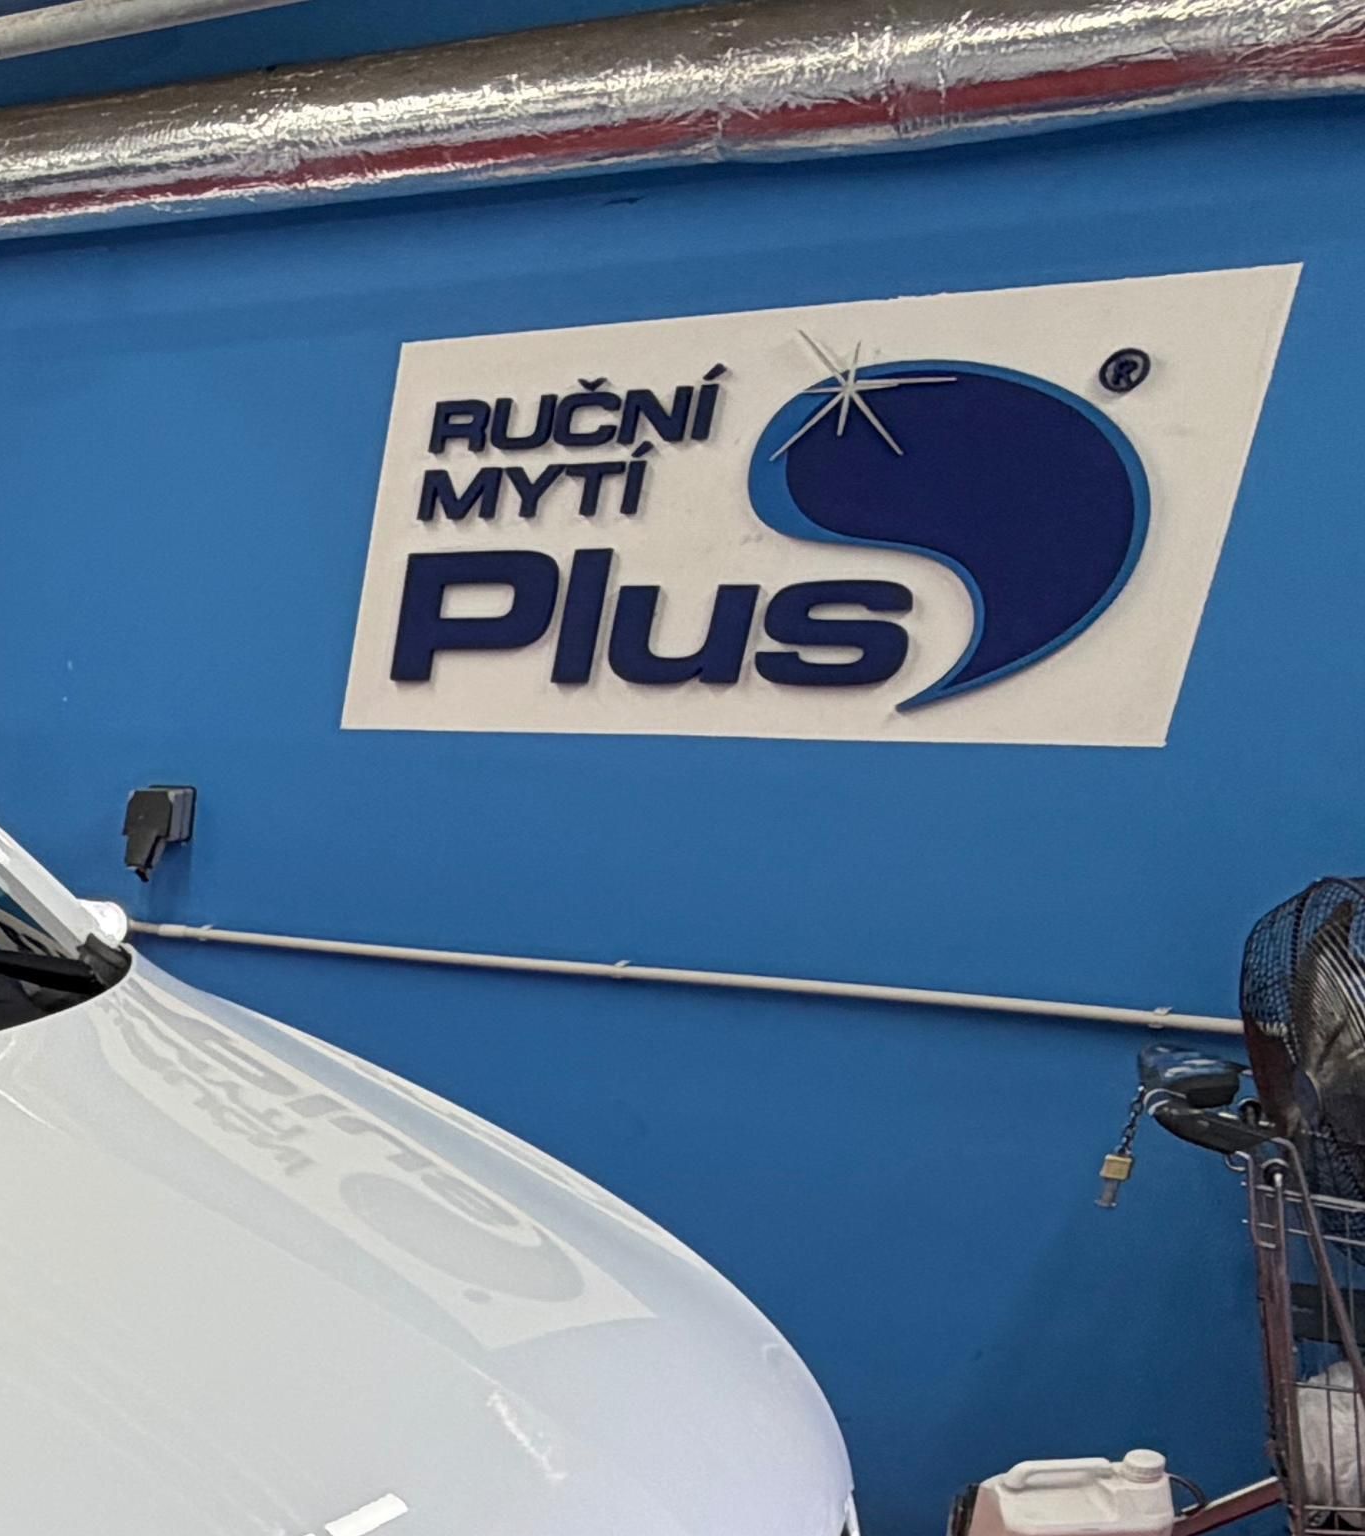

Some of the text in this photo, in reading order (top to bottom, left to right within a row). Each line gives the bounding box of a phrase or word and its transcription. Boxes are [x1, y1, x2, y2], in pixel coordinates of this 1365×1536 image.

[428, 363, 728, 455] RUČNÍ
[415, 441, 656, 521] MYTÍ
[388, 548, 914, 686] Plus
